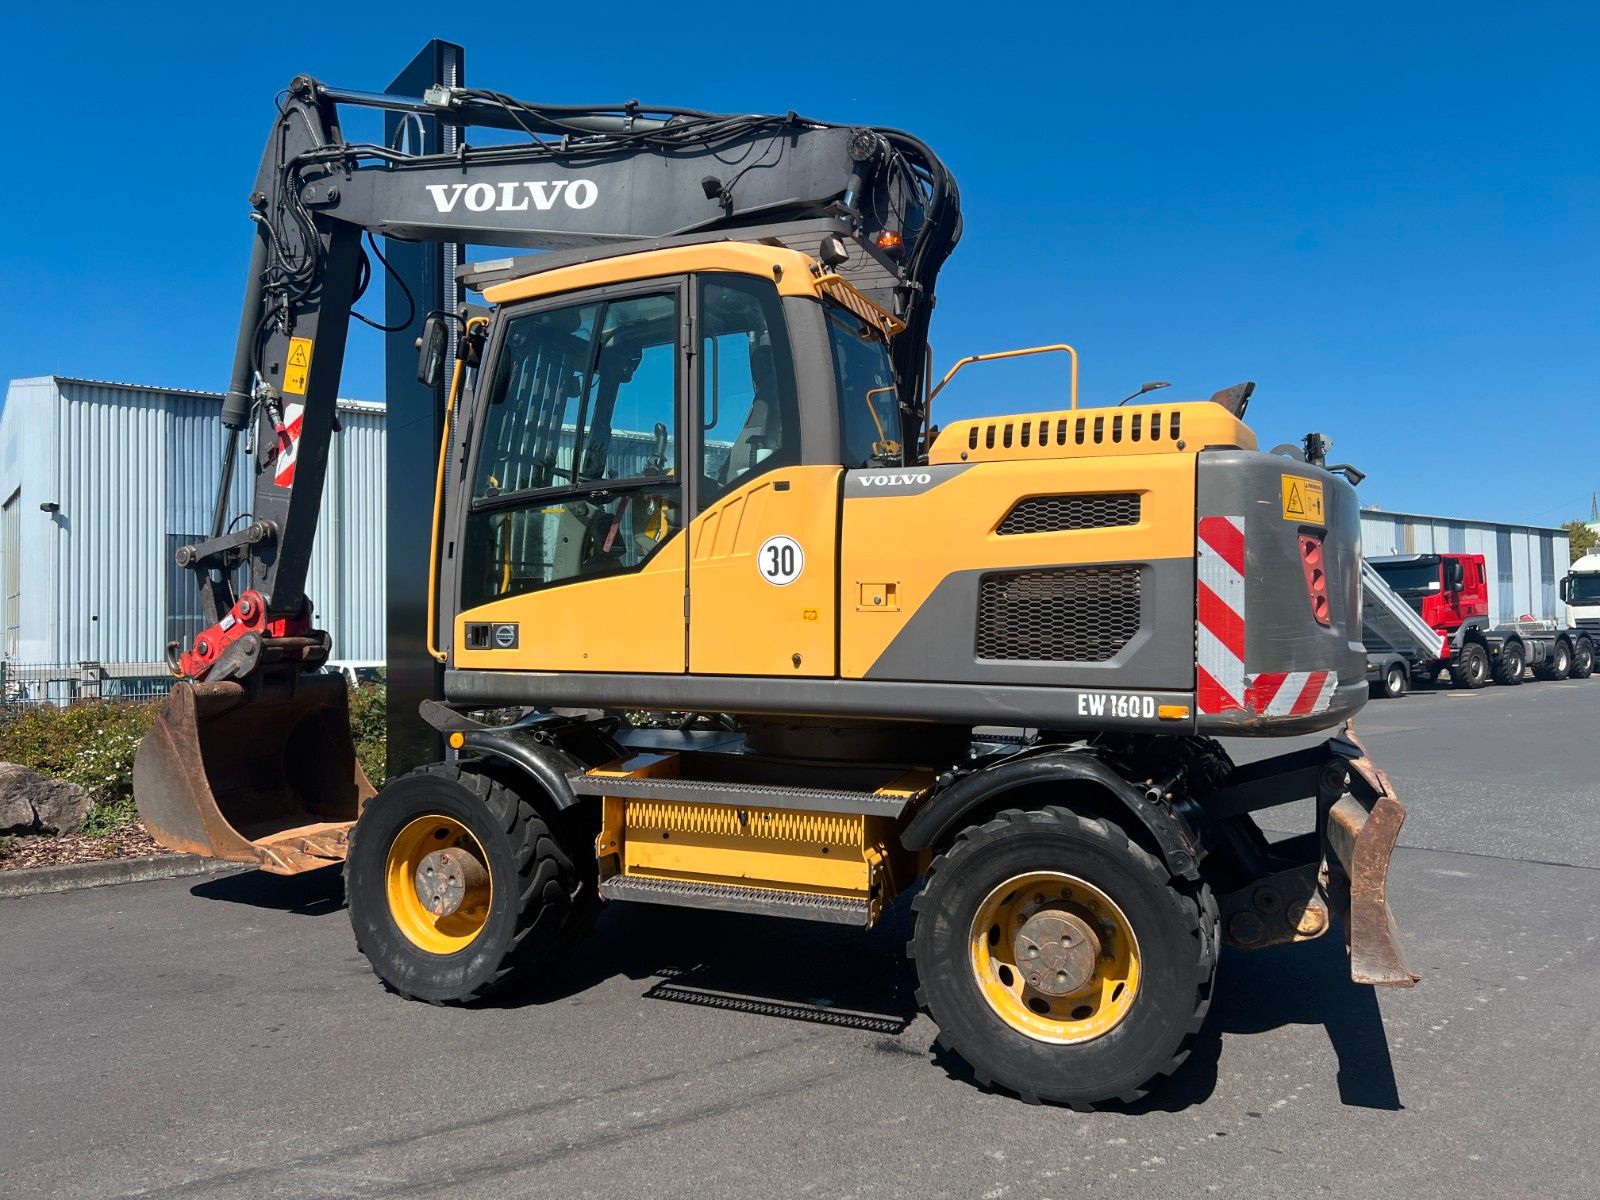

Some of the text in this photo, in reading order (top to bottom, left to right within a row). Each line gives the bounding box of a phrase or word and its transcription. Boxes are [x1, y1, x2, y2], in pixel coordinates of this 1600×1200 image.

[426, 179, 599, 213] VOLVO
[858, 473, 932, 487] VOLVO
[767, 545, 795, 577] 30
